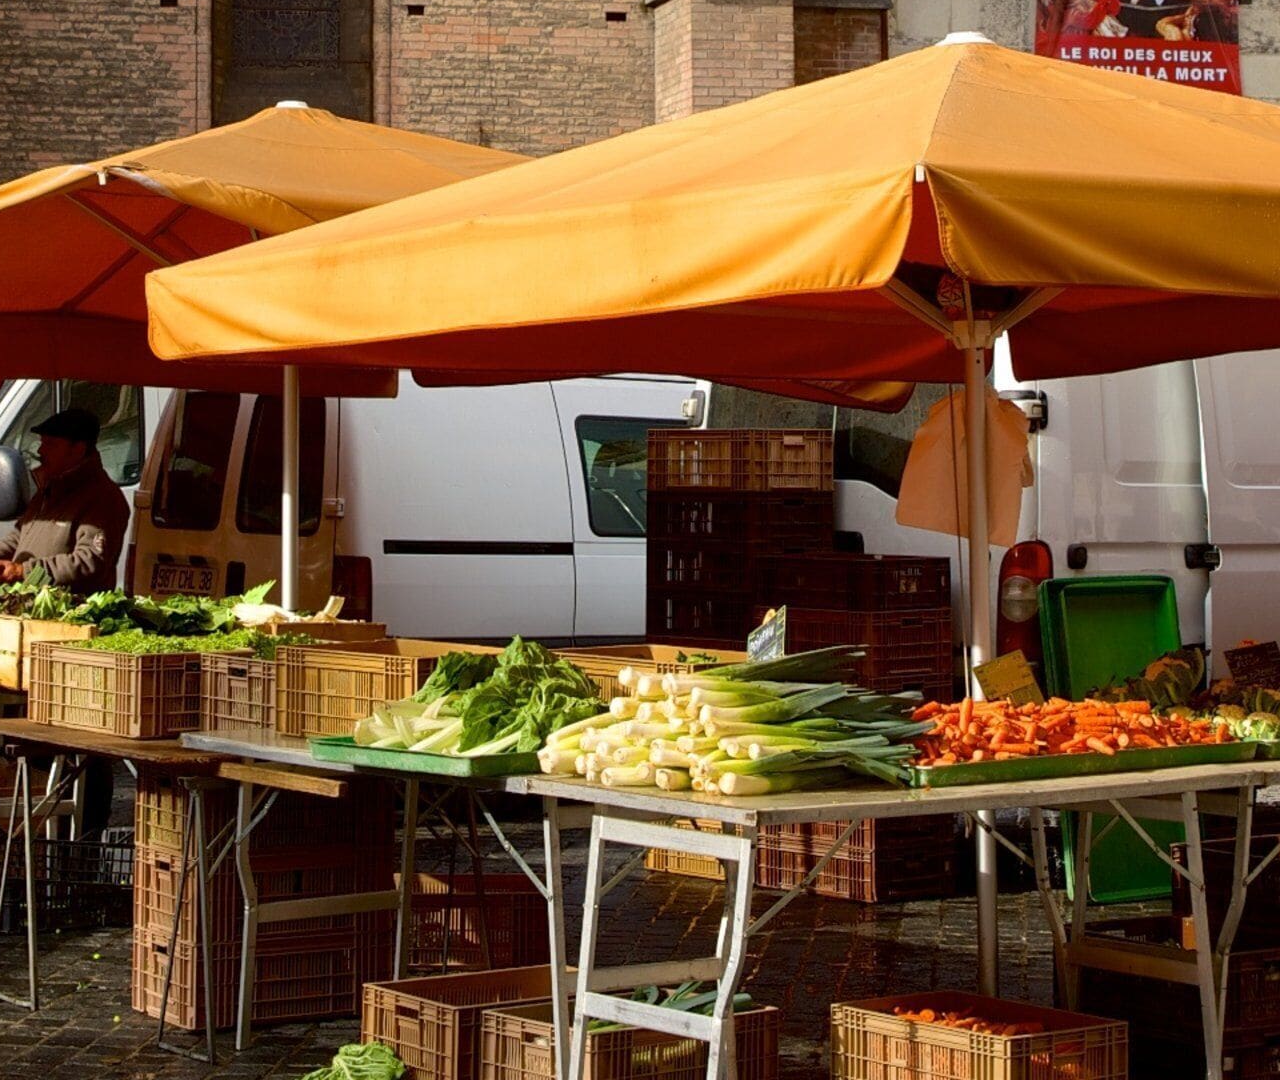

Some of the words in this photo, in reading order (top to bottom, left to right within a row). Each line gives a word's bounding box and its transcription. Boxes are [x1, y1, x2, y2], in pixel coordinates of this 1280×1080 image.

[1060, 47, 1082, 59] LE
[1088, 47, 1117, 60] ROI
[1124, 48, 1155, 61] DES
[1162, 50, 1213, 63] CIEUX
[1145, 67, 1168, 80] LA
[1175, 68, 1228, 82] MORT
